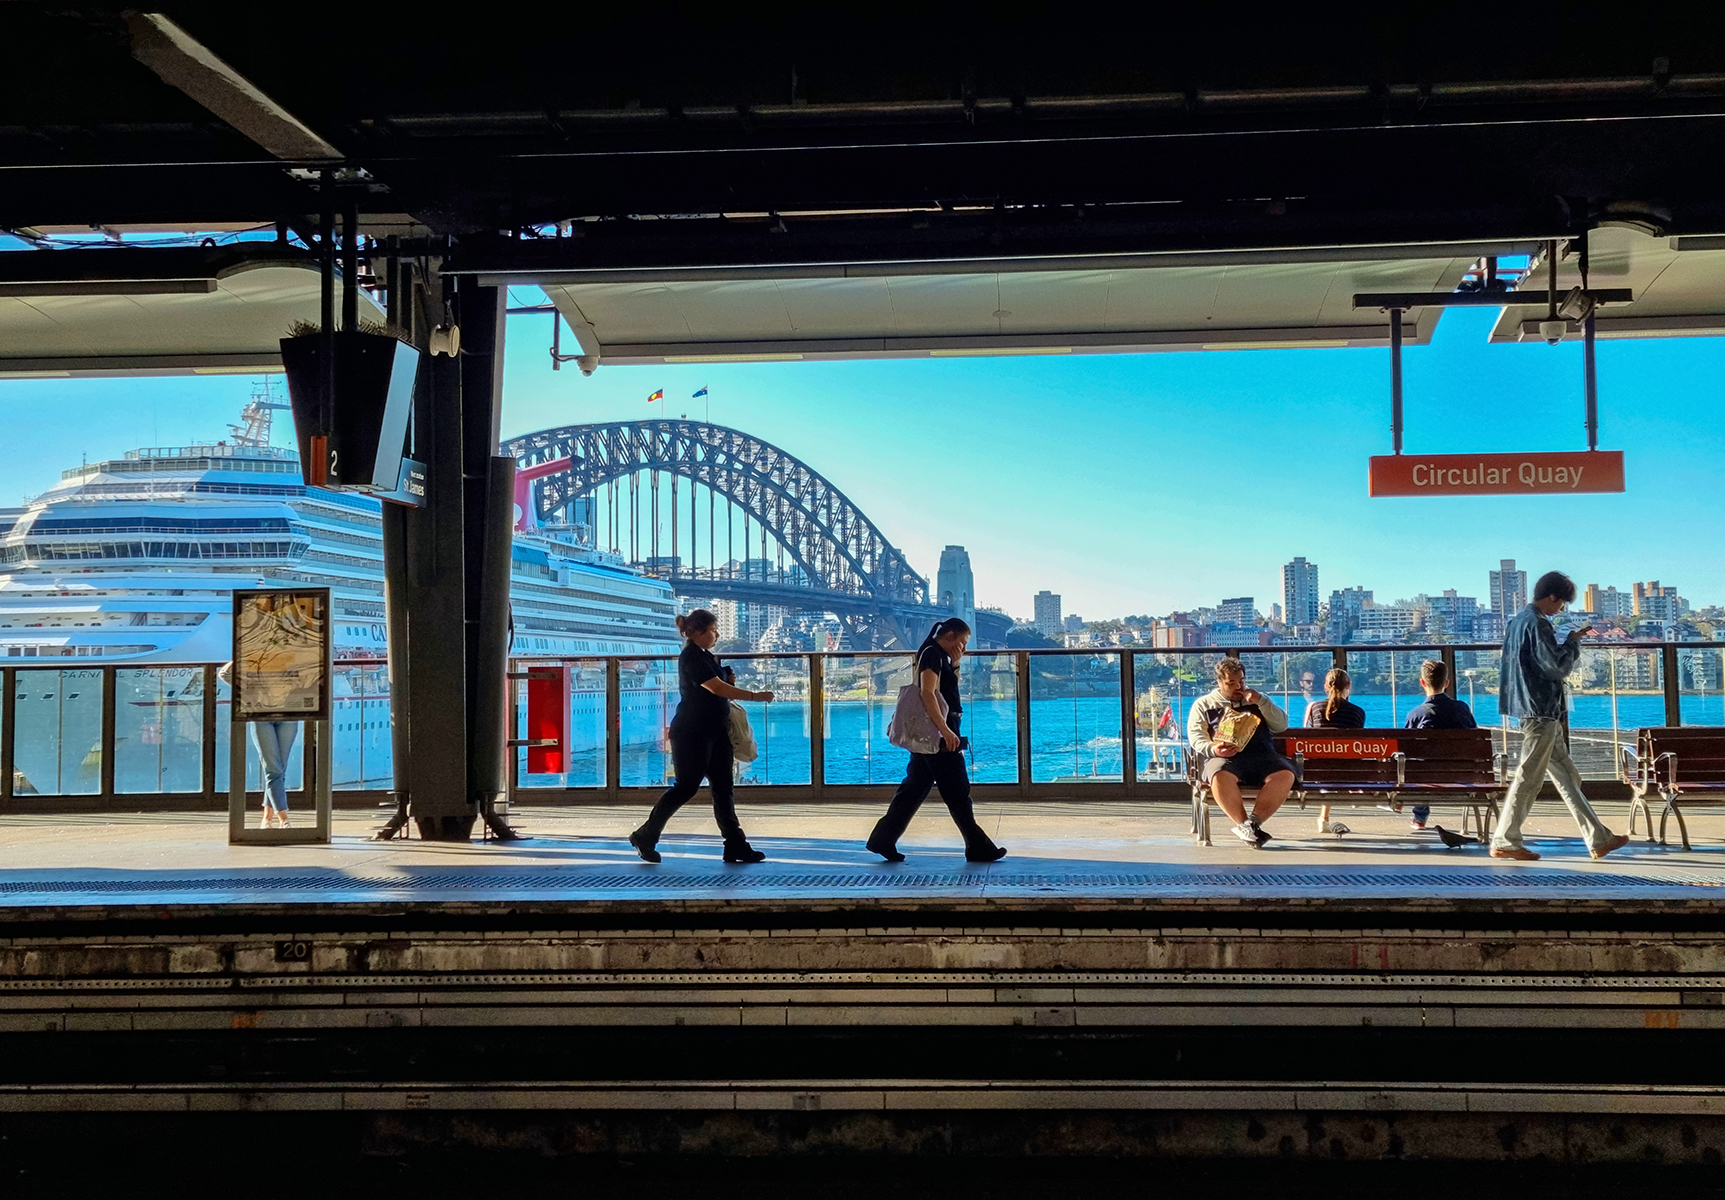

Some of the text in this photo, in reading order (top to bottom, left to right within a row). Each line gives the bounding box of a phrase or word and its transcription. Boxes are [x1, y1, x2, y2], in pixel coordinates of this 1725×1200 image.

[330, 450, 338, 476] 2
[1412, 462, 1584, 488] Circular Quay
[403, 478, 425, 497] St James
[134, 667, 194, 678] SPLENDOR
[1295, 741, 1388, 756] Circular Quay
[283, 942, 307, 958] 20
